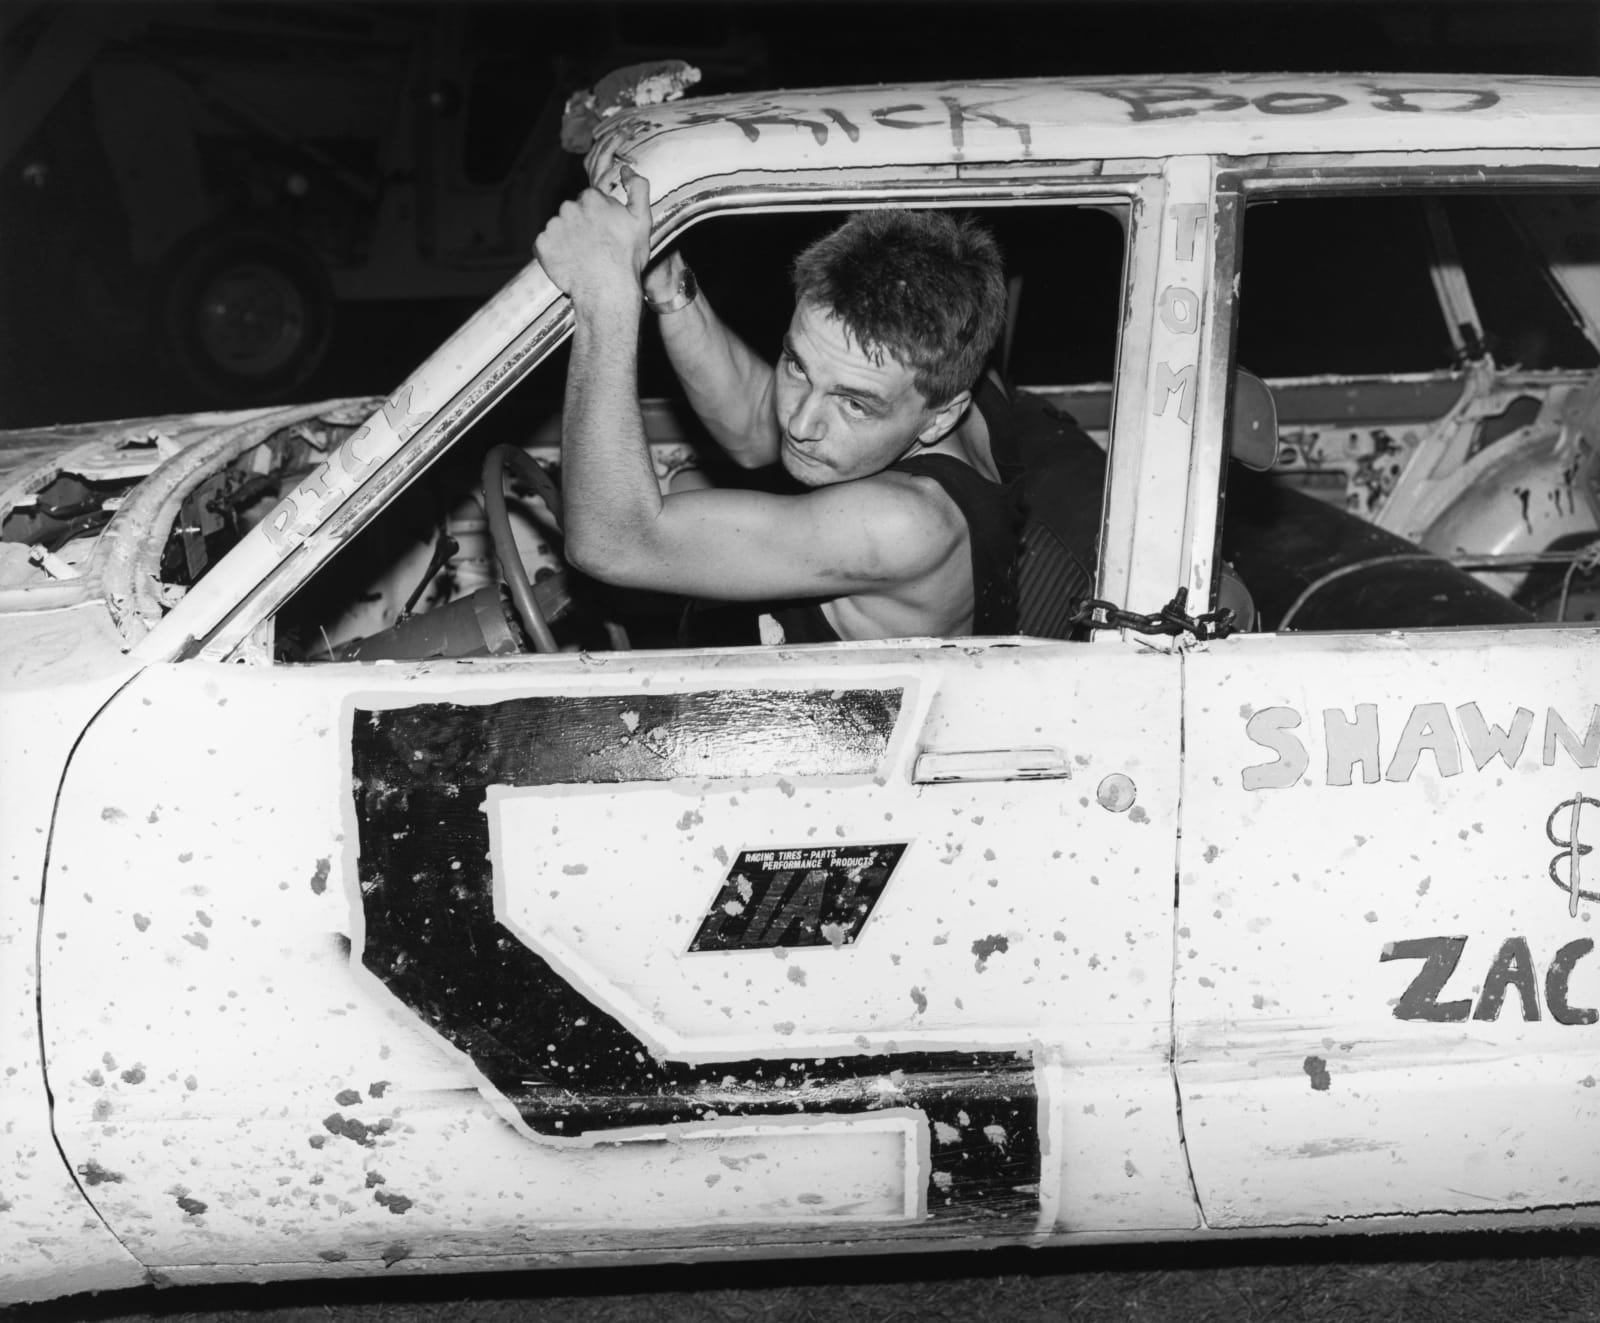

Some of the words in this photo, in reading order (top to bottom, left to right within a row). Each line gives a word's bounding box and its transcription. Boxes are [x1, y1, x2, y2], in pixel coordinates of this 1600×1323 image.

[1152, 202, 1208, 425] TOM
[1241, 700, 1600, 791] SHAWN
[744, 852, 775, 863] RACING
[762, 859, 823, 871] PERFORMANCE
[830, 856, 875, 867] PRODUCTS
